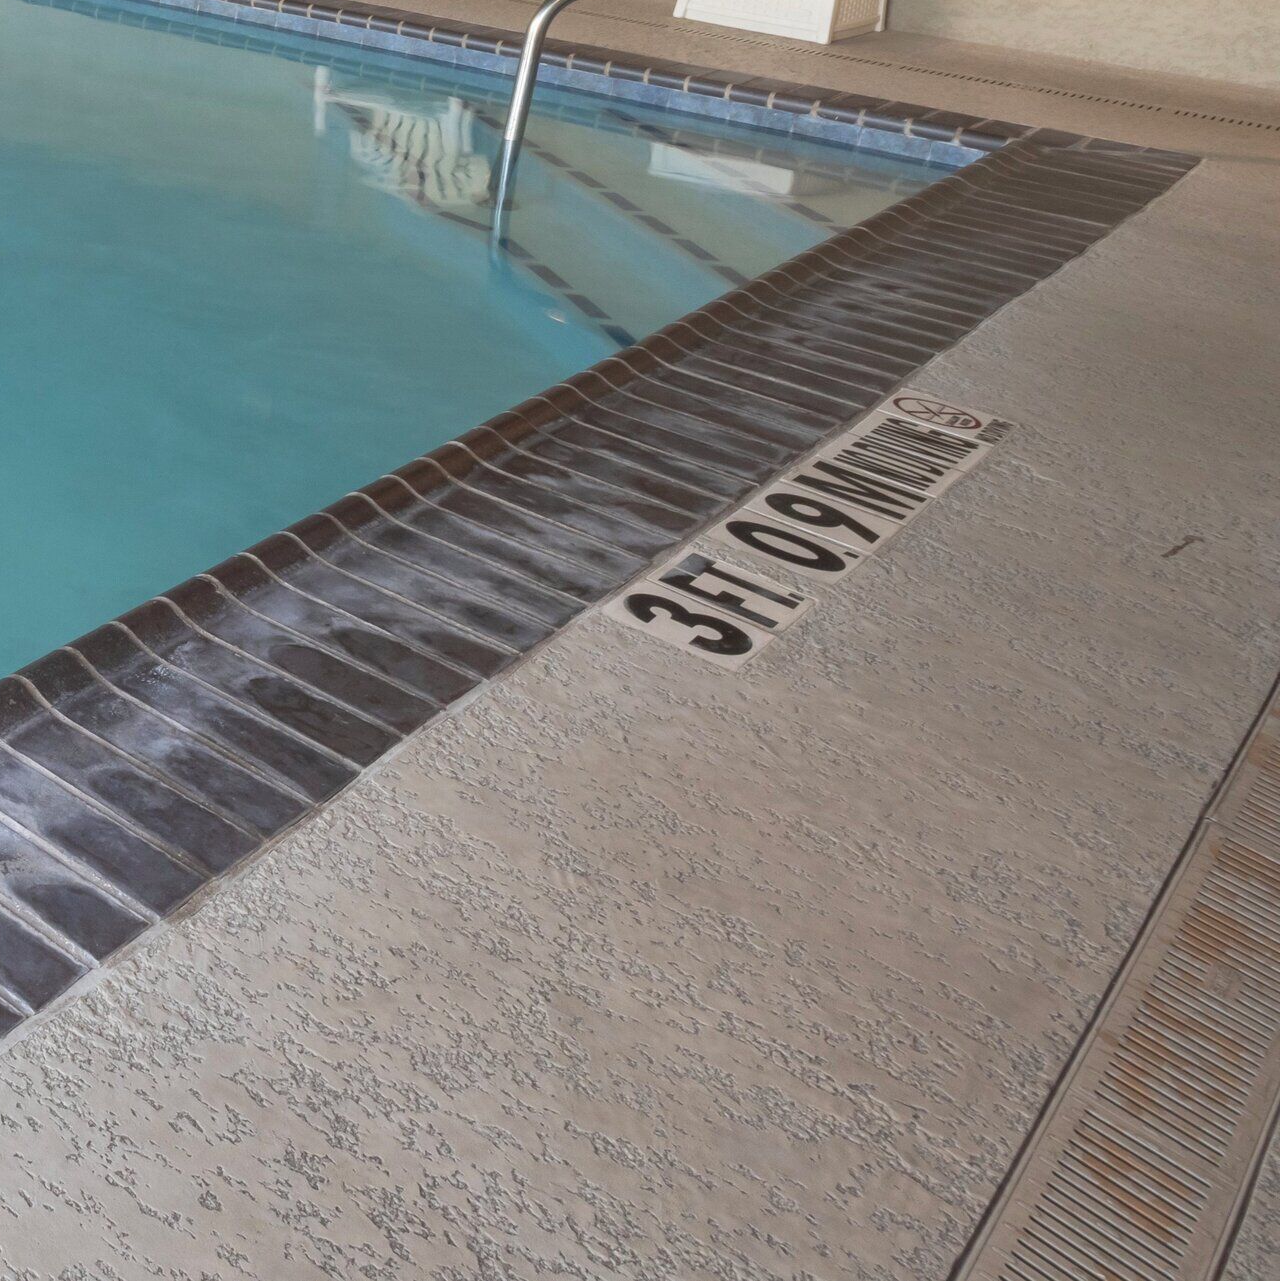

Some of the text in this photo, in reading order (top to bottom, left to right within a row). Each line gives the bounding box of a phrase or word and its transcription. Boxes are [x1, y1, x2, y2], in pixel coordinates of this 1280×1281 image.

[833, 448, 938, 492] NO
[850, 417, 980, 477] DIVING
[624, 592, 753, 656] 3
